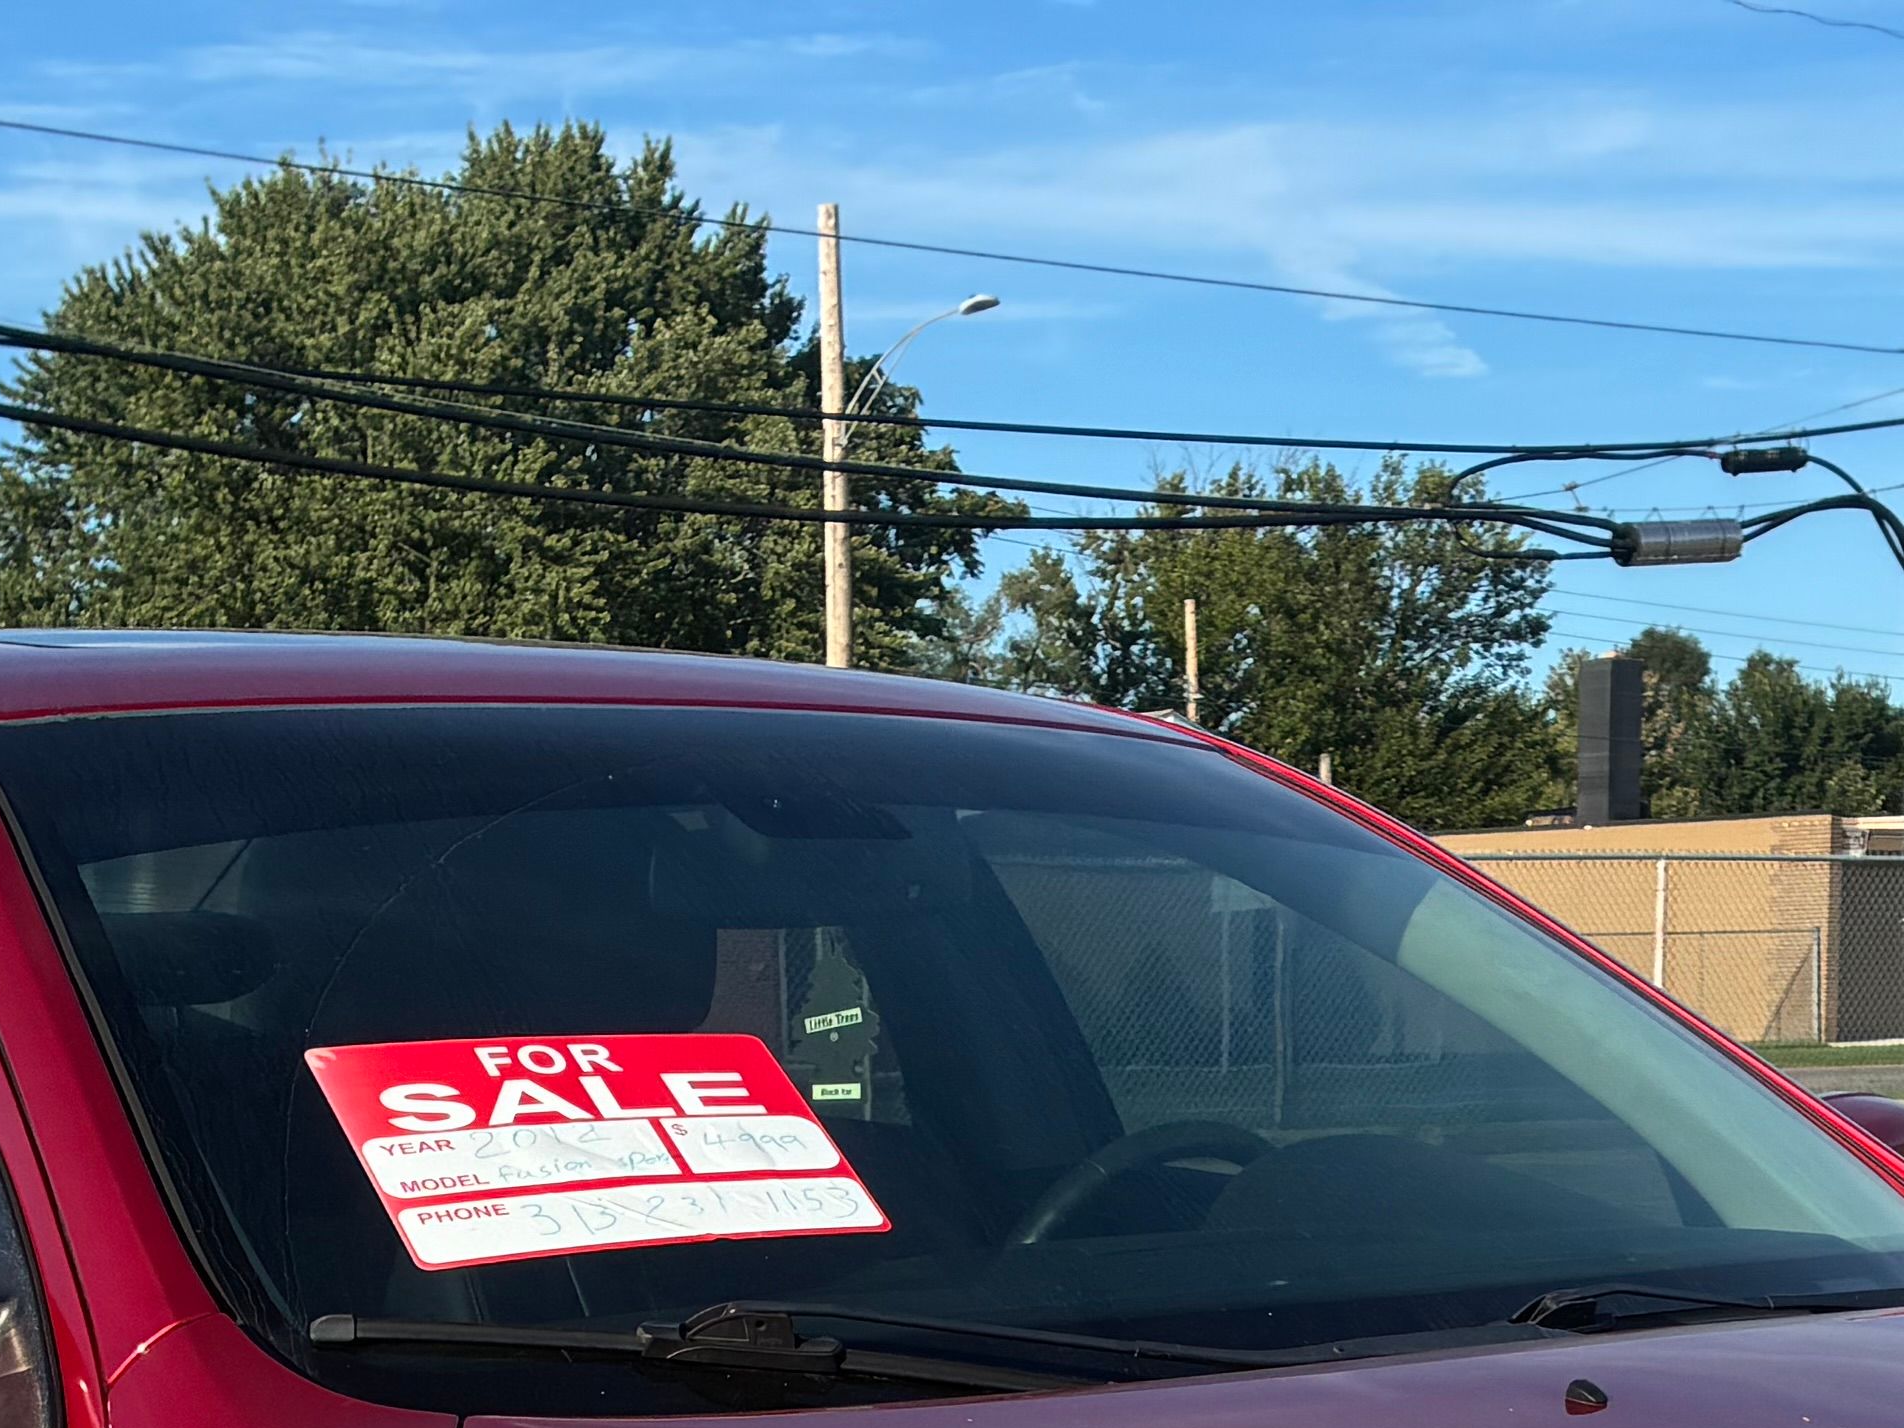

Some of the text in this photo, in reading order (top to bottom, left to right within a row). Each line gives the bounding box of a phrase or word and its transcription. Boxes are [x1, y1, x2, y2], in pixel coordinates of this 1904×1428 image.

[473, 1043, 625, 1078] FOR
[379, 1072, 769, 1132] SALE
[469, 1124, 613, 1159] 2012
[671, 1123, 689, 1137] $
[702, 1127, 808, 1153] 4999
[380, 1138, 456, 1157] YEAR
[400, 1173, 491, 1194] MODEL
[417, 1203, 511, 1226] PHONE
[520, 1185, 859, 1236] 313 231 1153
